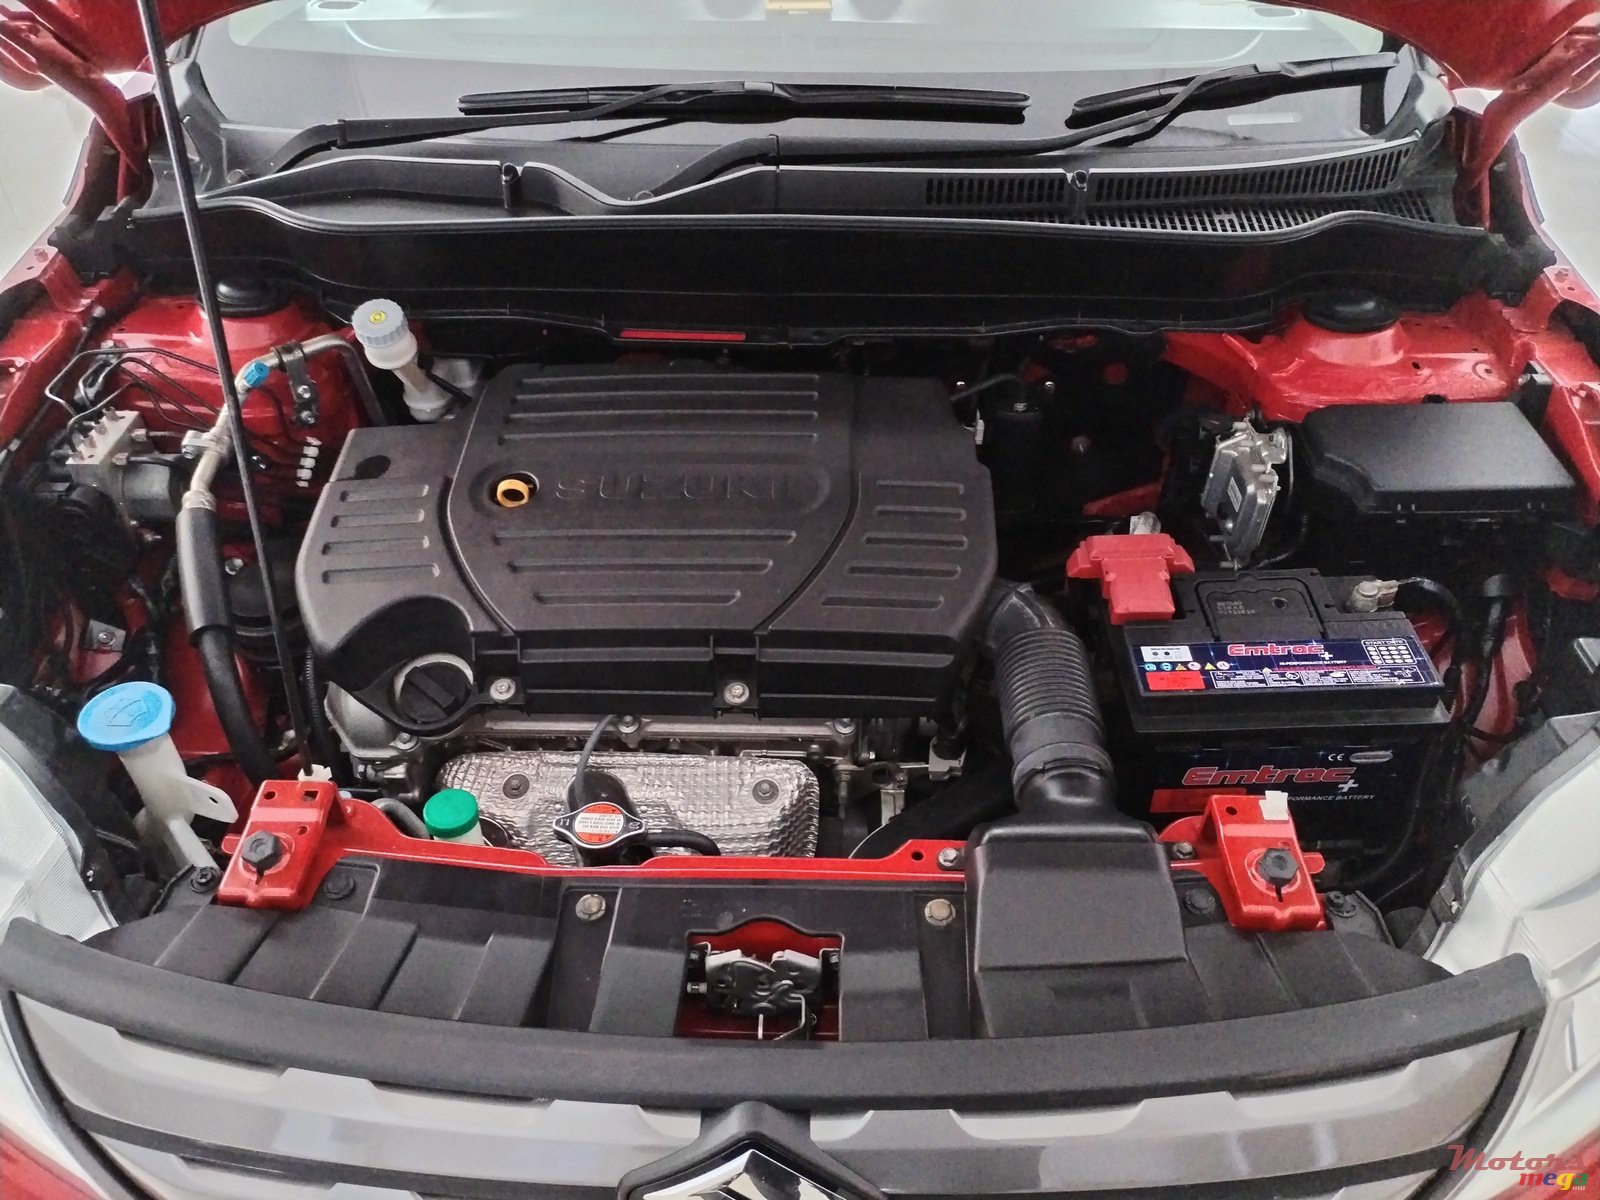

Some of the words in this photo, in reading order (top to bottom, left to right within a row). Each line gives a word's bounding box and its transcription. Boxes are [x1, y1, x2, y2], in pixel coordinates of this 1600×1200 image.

[556, 474, 776, 499] SUZUKI
[1227, 643, 1324, 656] Emtrac
[1182, 765, 1357, 785] Emtrac
